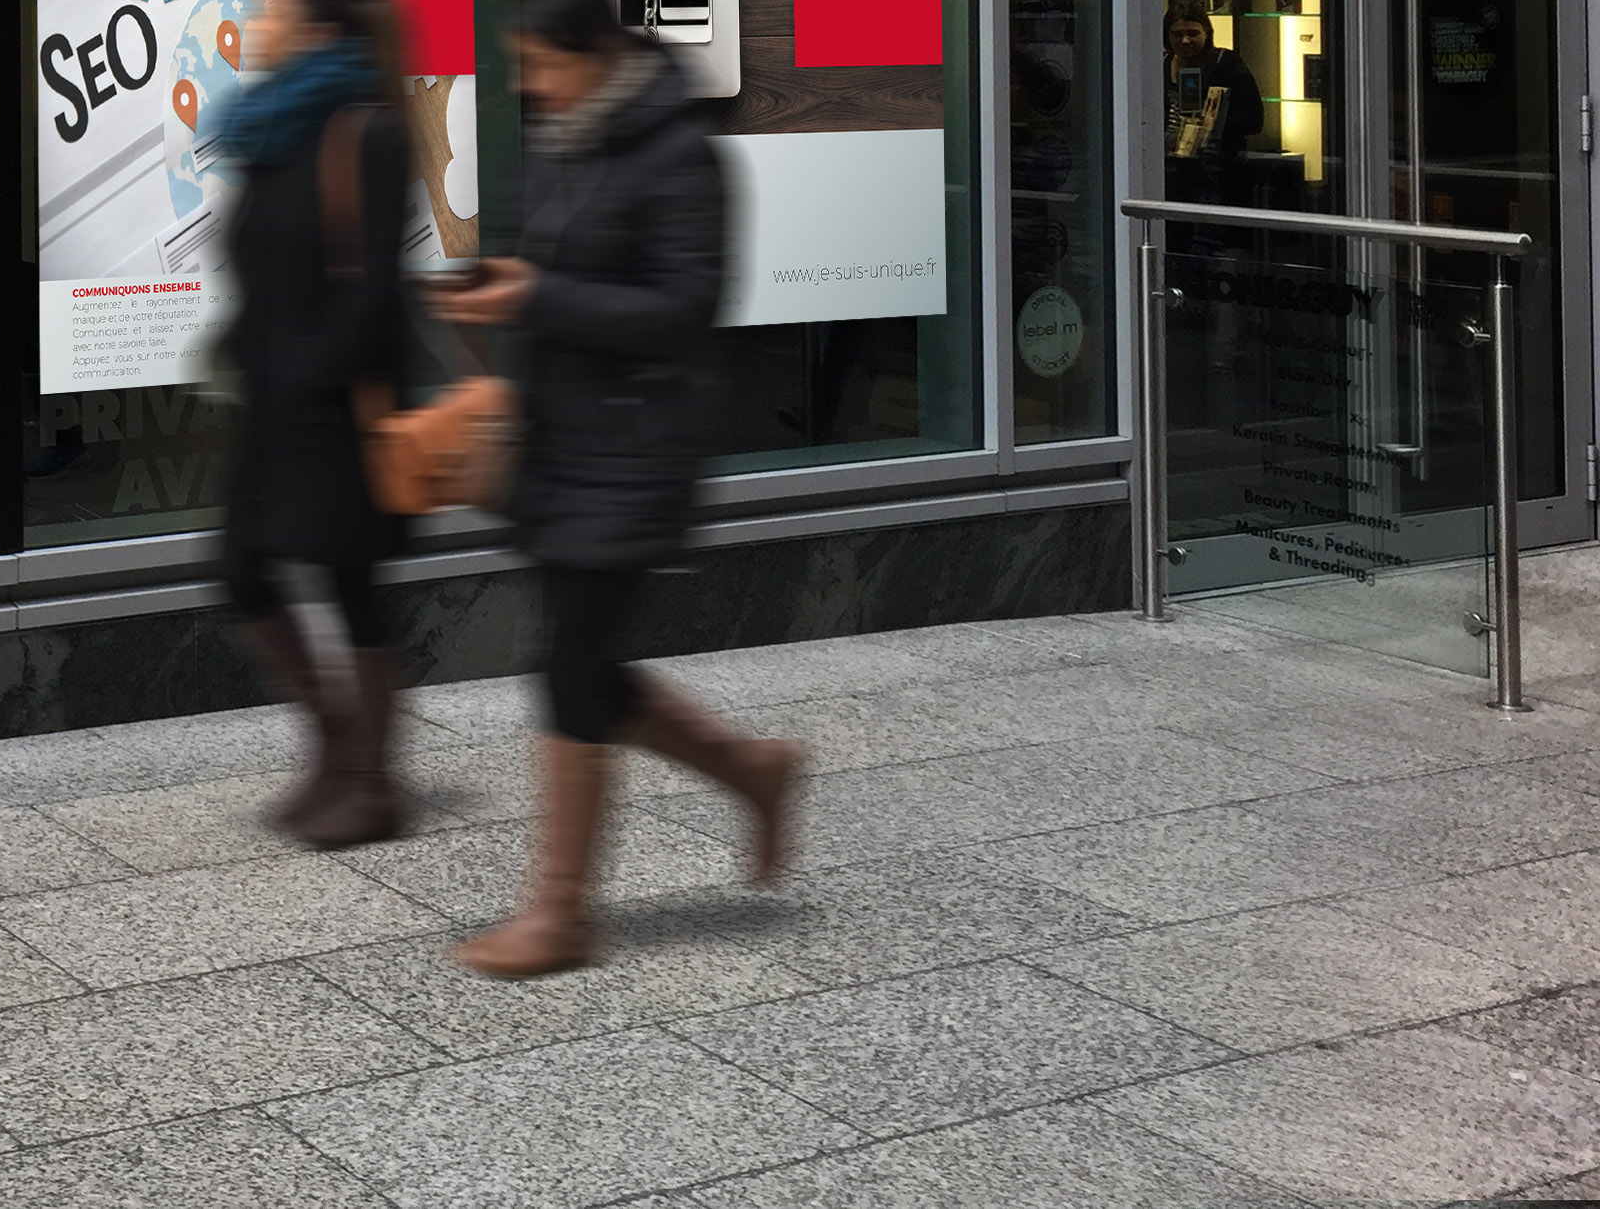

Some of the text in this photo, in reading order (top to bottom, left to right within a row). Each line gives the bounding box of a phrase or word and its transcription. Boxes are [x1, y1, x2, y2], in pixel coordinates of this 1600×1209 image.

[1432, 52, 1497, 70] WINNER
[40, 4, 158, 144] SEO
[773, 258, 936, 286] www.je-suis-unique.fr
[72, 281, 201, 298] COMMUNIQUONS ENSEMBLE
[72, 300, 121, 313] Augmentez
[146, 295, 200, 308] rayonnement
[73, 315, 106, 327] marque
[120, 312, 130, 322] de
[1023, 322, 1078, 337] label m
[1233, 424, 1288, 445] Keratin
[1263, 461, 1318, 483] Private
[1244, 489, 1297, 511] Beauty
[1269, 546, 1281, 562] &
